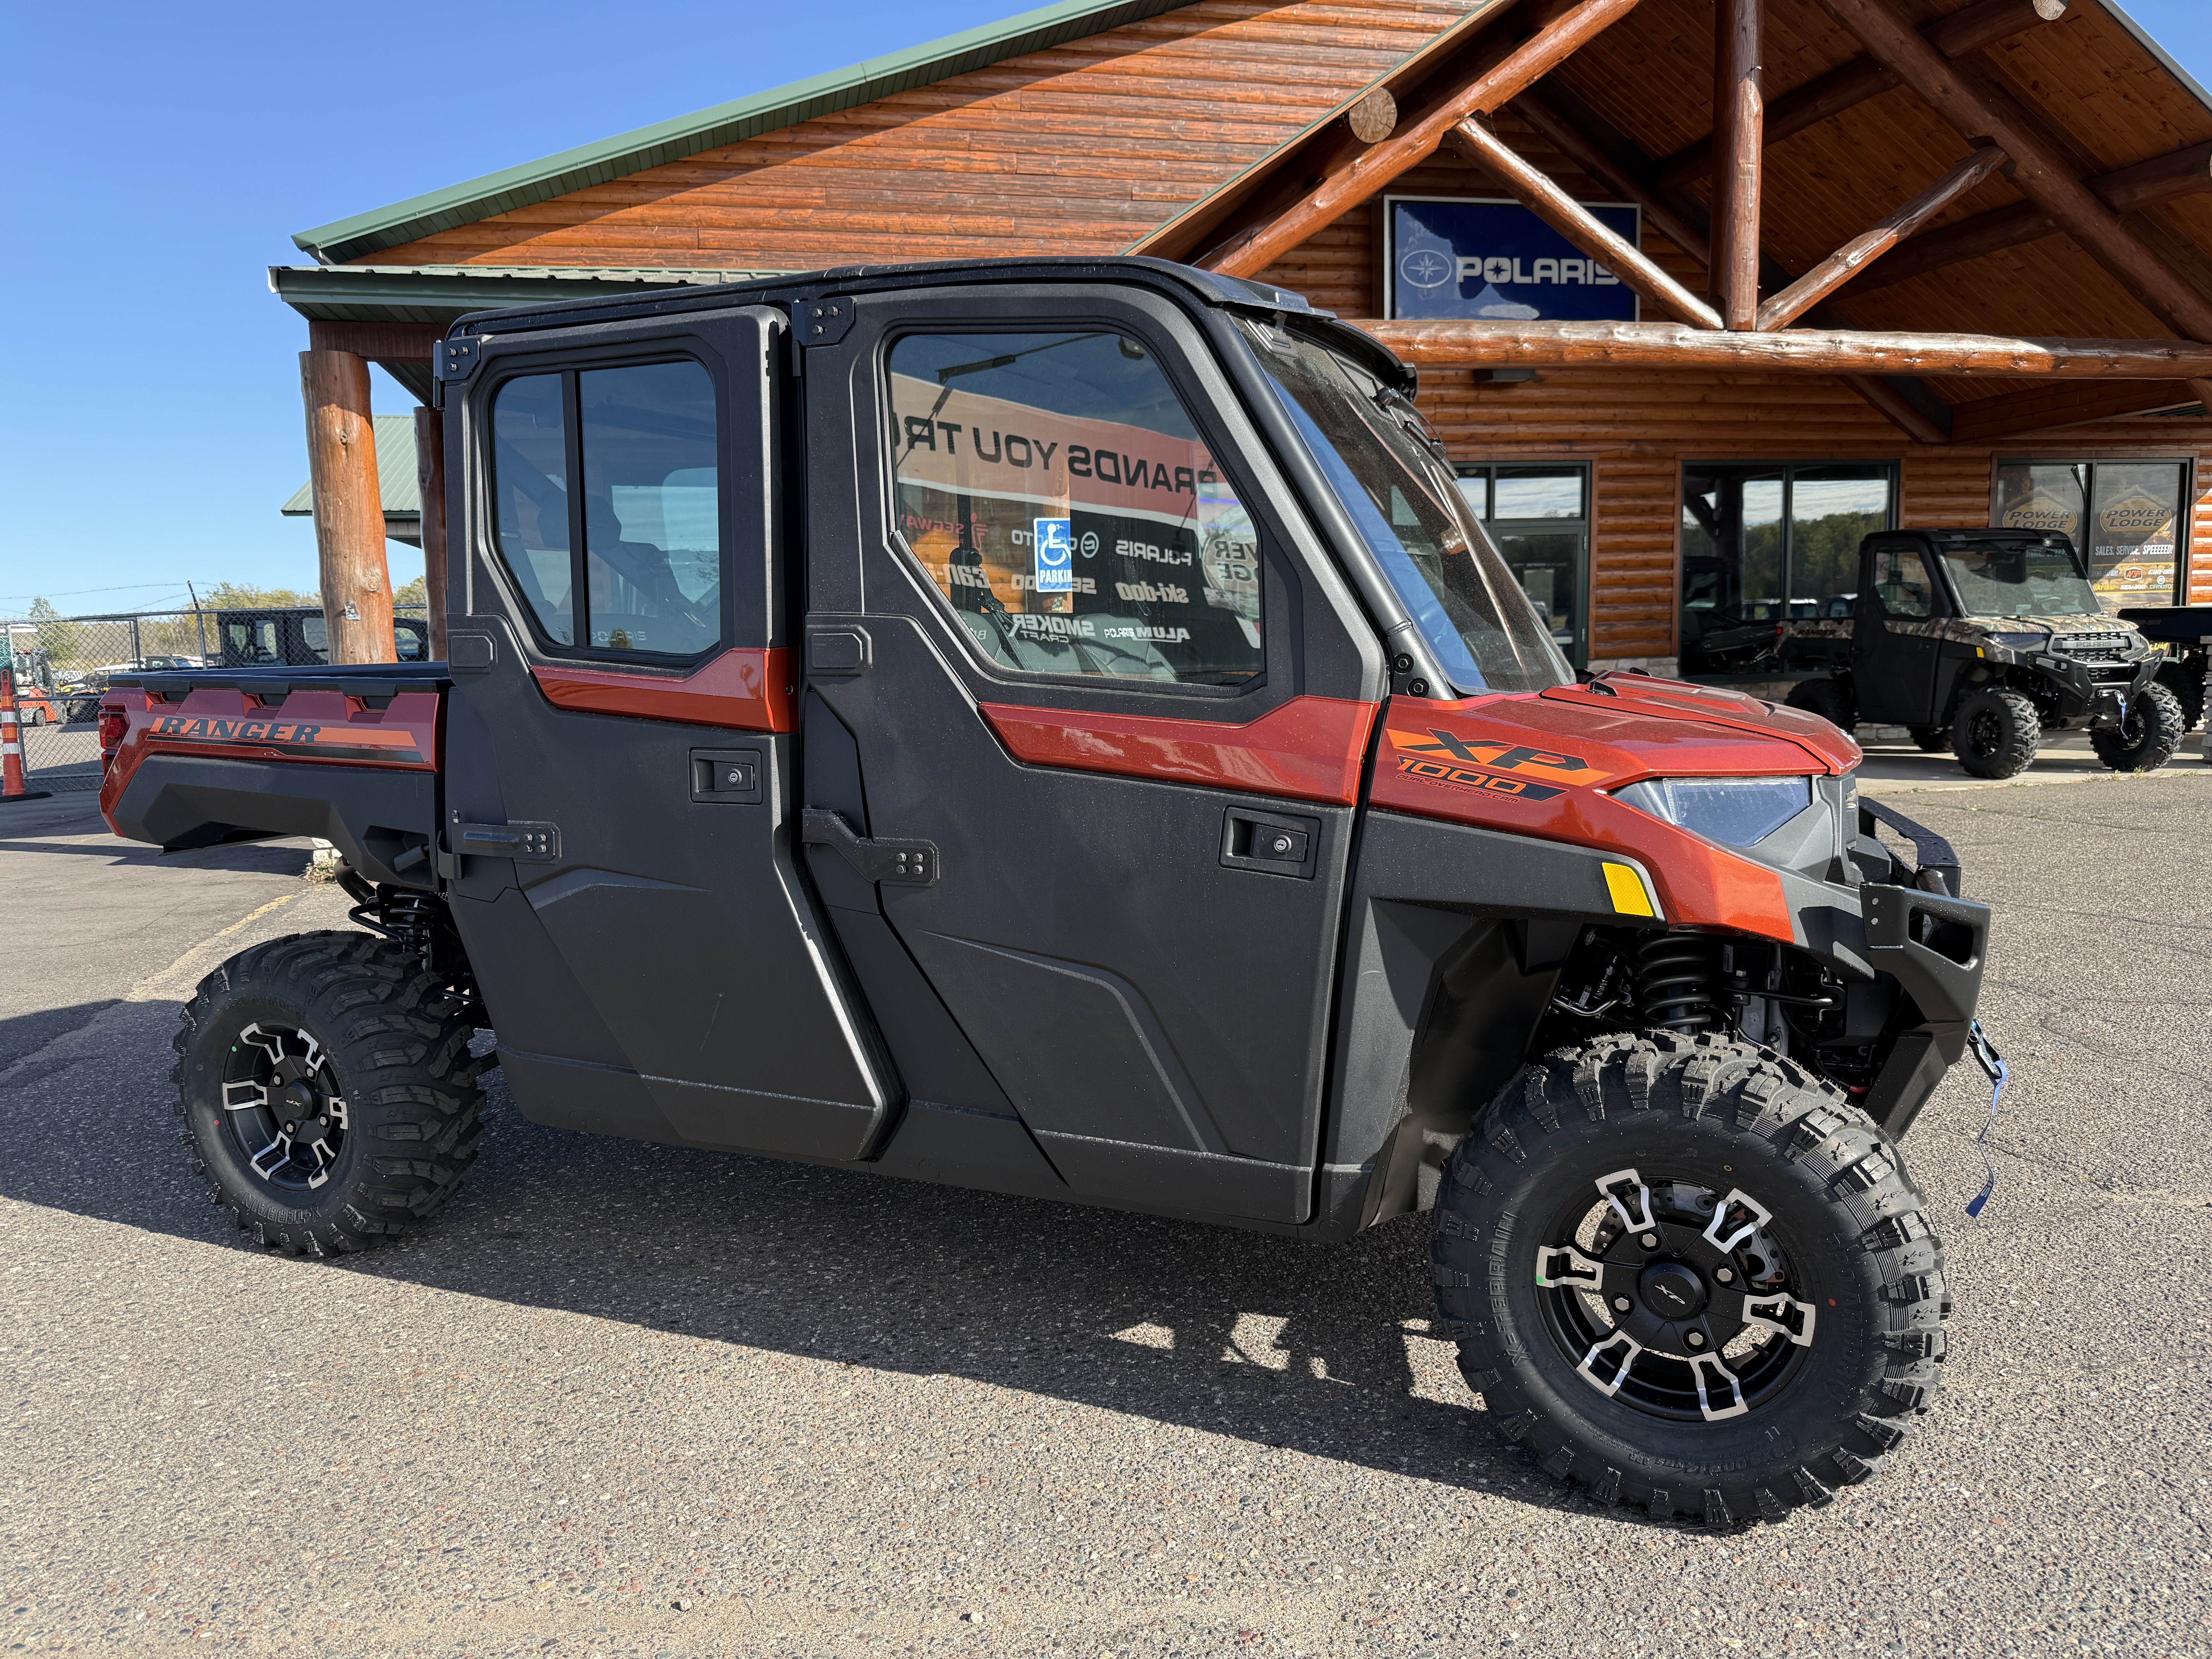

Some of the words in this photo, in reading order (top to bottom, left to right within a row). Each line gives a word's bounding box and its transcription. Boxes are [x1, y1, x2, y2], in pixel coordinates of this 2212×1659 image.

[1456, 256, 1620, 285] POLARIS
[2009, 510, 2071, 521] POWER
[2106, 509, 2166, 520] POWER
[2012, 520, 2068, 529] LODGE
[2108, 519, 2162, 527] LODGE
[2095, 545, 2114, 556] SALES.
[2116, 545, 2140, 555] SERVICE.
[1104, 627, 1135, 639] POLARIS
[158, 716, 321, 744] RANGER
[1400, 728, 1589, 771] XP
[1397, 759, 1527, 794] 1000
[1488, 1211, 1533, 1367] X-TERRAIN
